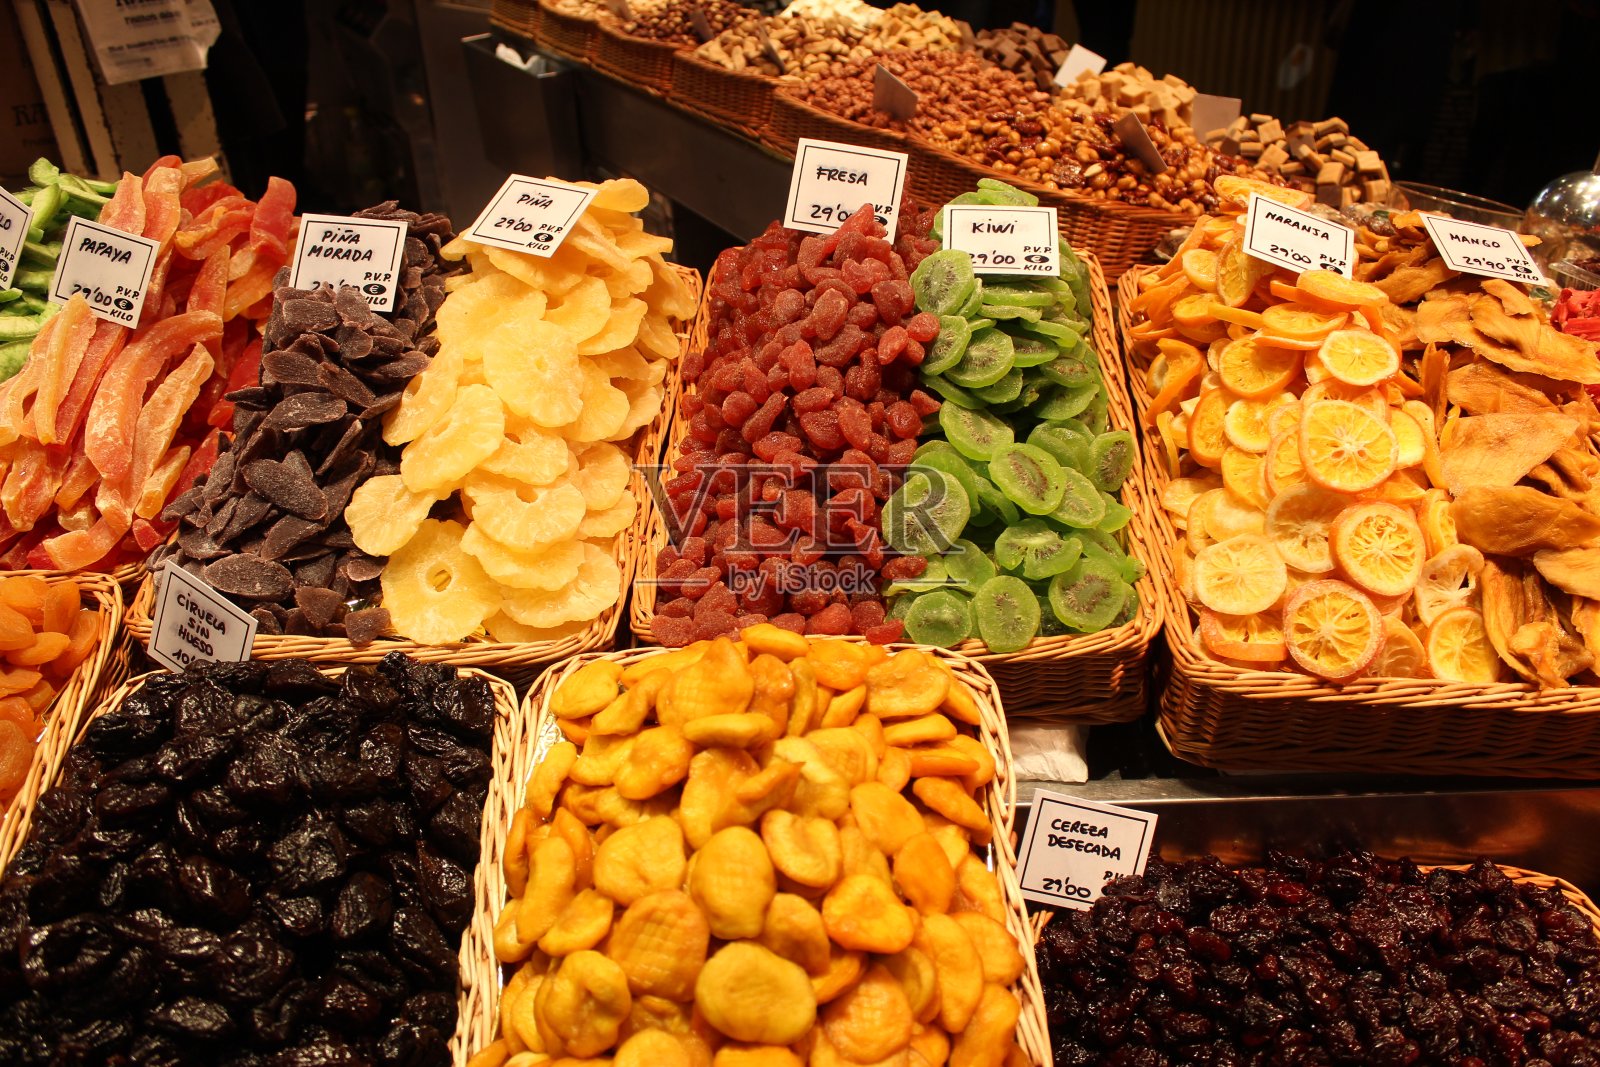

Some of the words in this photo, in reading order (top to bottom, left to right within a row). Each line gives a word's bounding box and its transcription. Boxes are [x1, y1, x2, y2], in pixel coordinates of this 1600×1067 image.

[816, 166, 868, 186] FRESA
[516, 192, 554, 209] PIÑA
[810, 203, 854, 222] 29'0
[494, 217, 533, 232] 29'00
[538, 223, 564, 233] P.V.P.
[1265, 211, 1330, 240] NARANJA
[321, 228, 361, 245] PIÑA
[1449, 232, 1501, 248] MANGO
[79, 237, 133, 264] PAPAYA
[307, 245, 373, 262] MORADA
[525, 241, 551, 251] KILO
[1023, 245, 1052, 253] P.V.P.
[1462, 256, 1506, 270] 29'90
[363, 272, 392, 282] P.V.P.
[1515, 273, 1539, 281] KILO
[116, 285, 140, 300] P.V.P.
[109, 308, 134, 322] KILO
[176, 592, 226, 635] CIRUELA
[187, 616, 210, 639] SIN
[178, 624, 214, 656] HUESO
[172, 648, 196, 665] 10'
[1050, 818, 1109, 839] CEREZA
[1047, 833, 1121, 861] DESECADA
[1042, 876, 1091, 899] 29'00
